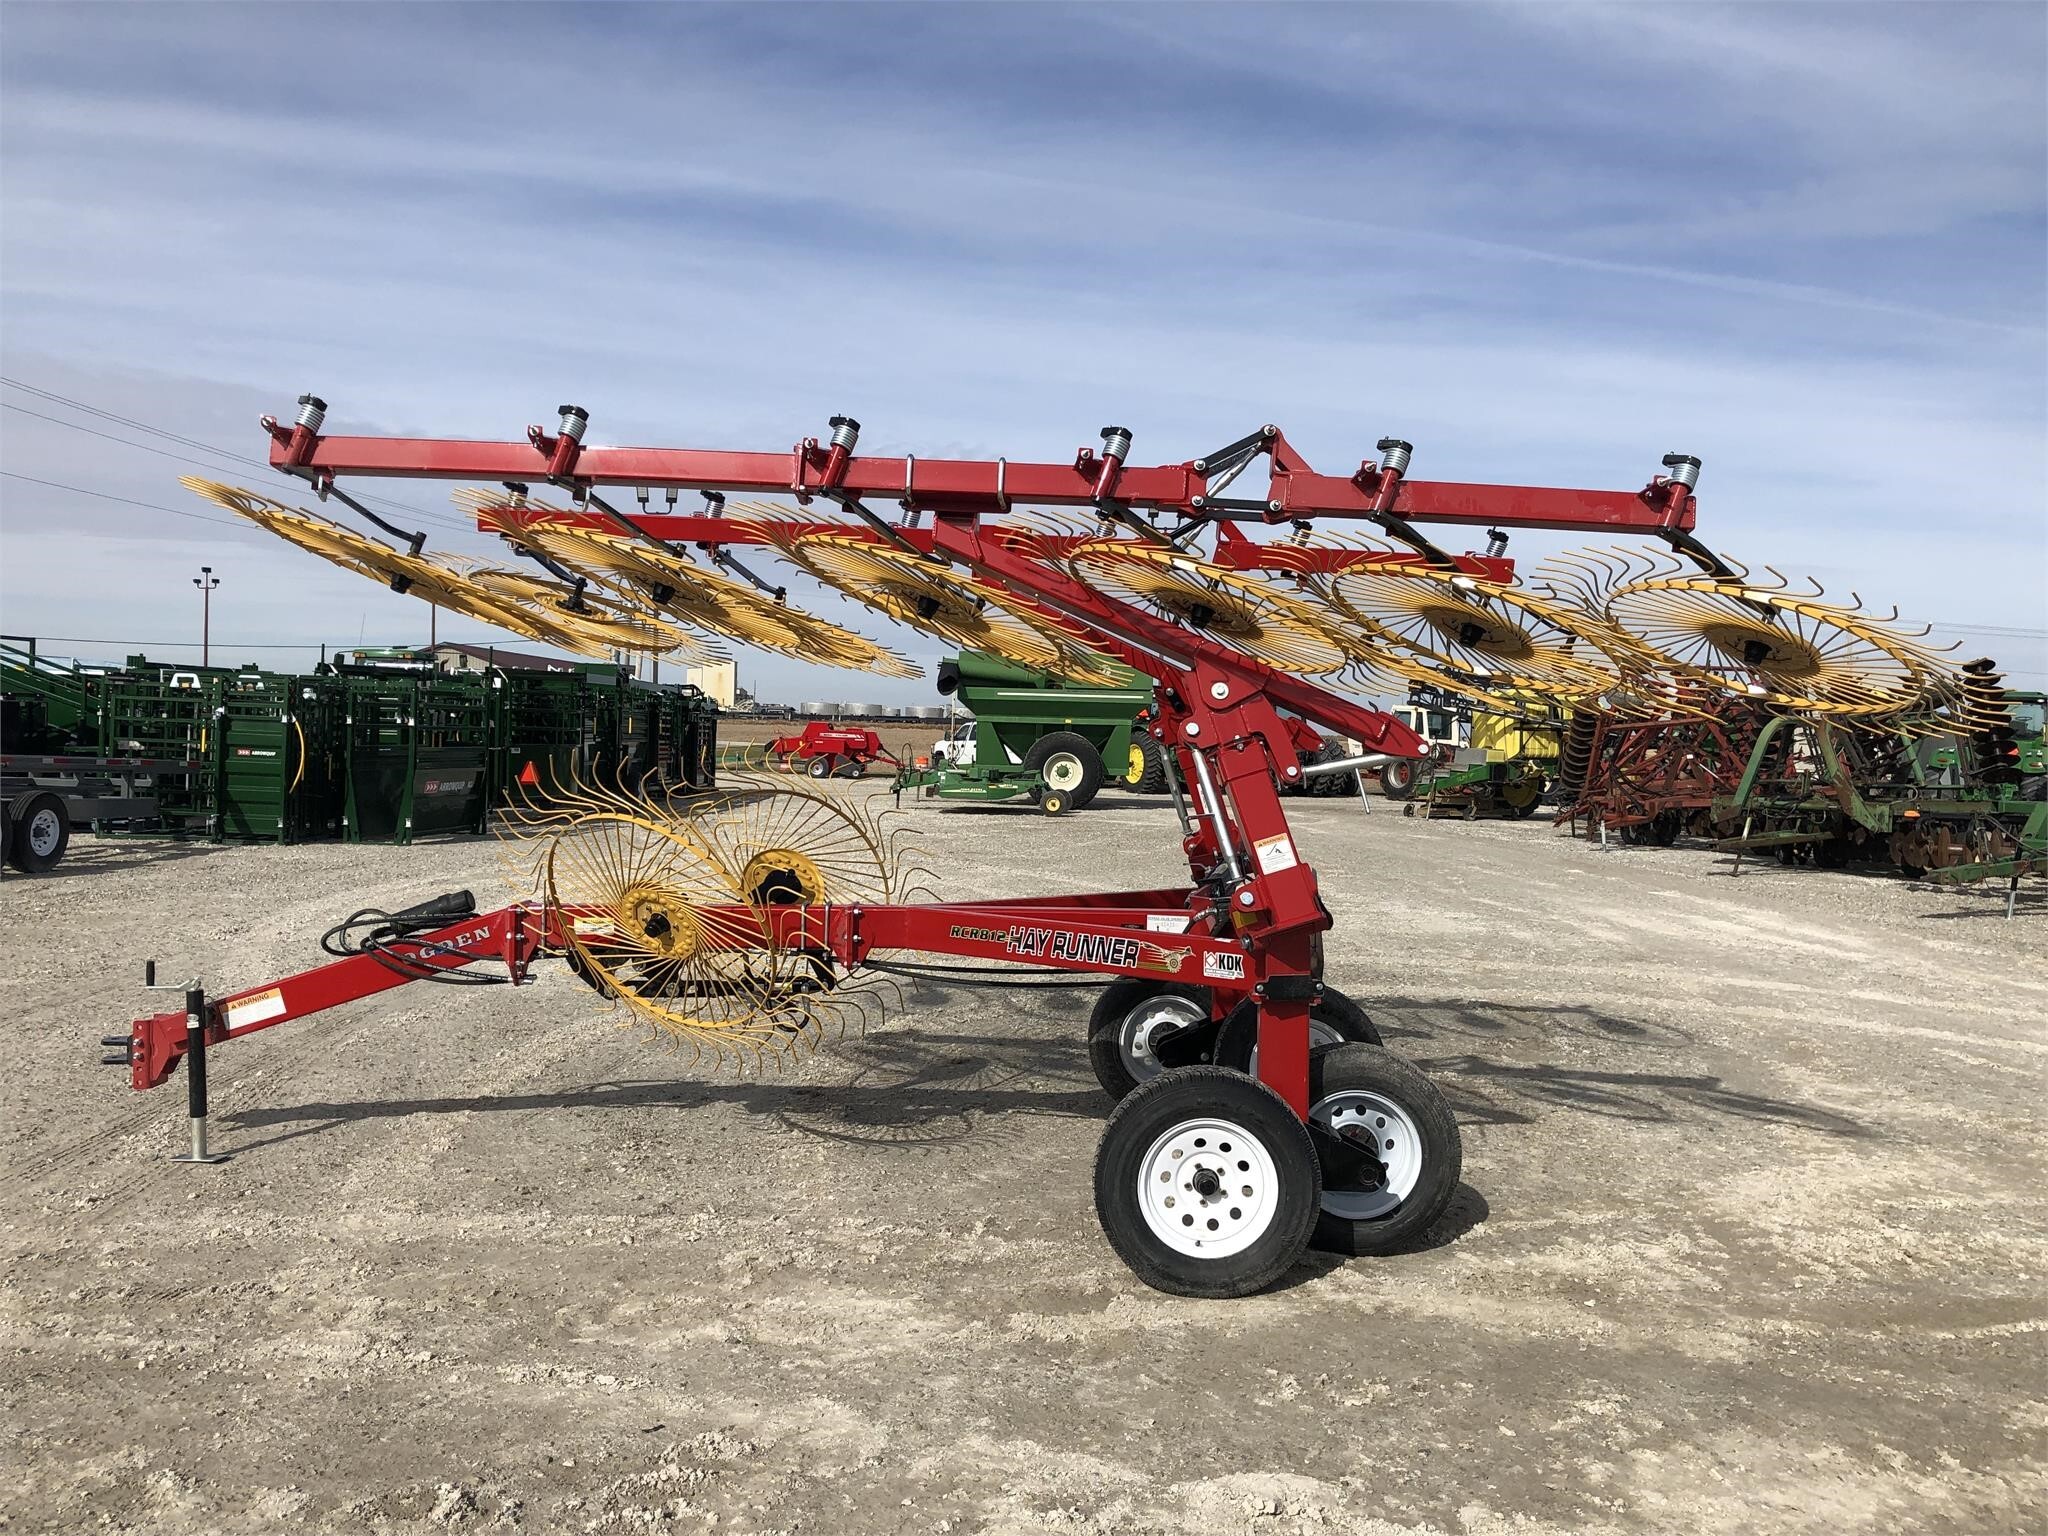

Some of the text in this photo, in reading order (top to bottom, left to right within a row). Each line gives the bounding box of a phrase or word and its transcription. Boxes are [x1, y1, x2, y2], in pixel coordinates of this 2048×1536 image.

[950, 925, 1141, 969] RCR812 HAY RUNNER
[1218, 954, 1242, 972] KDK
[236, 992, 270, 1007] WARNING
